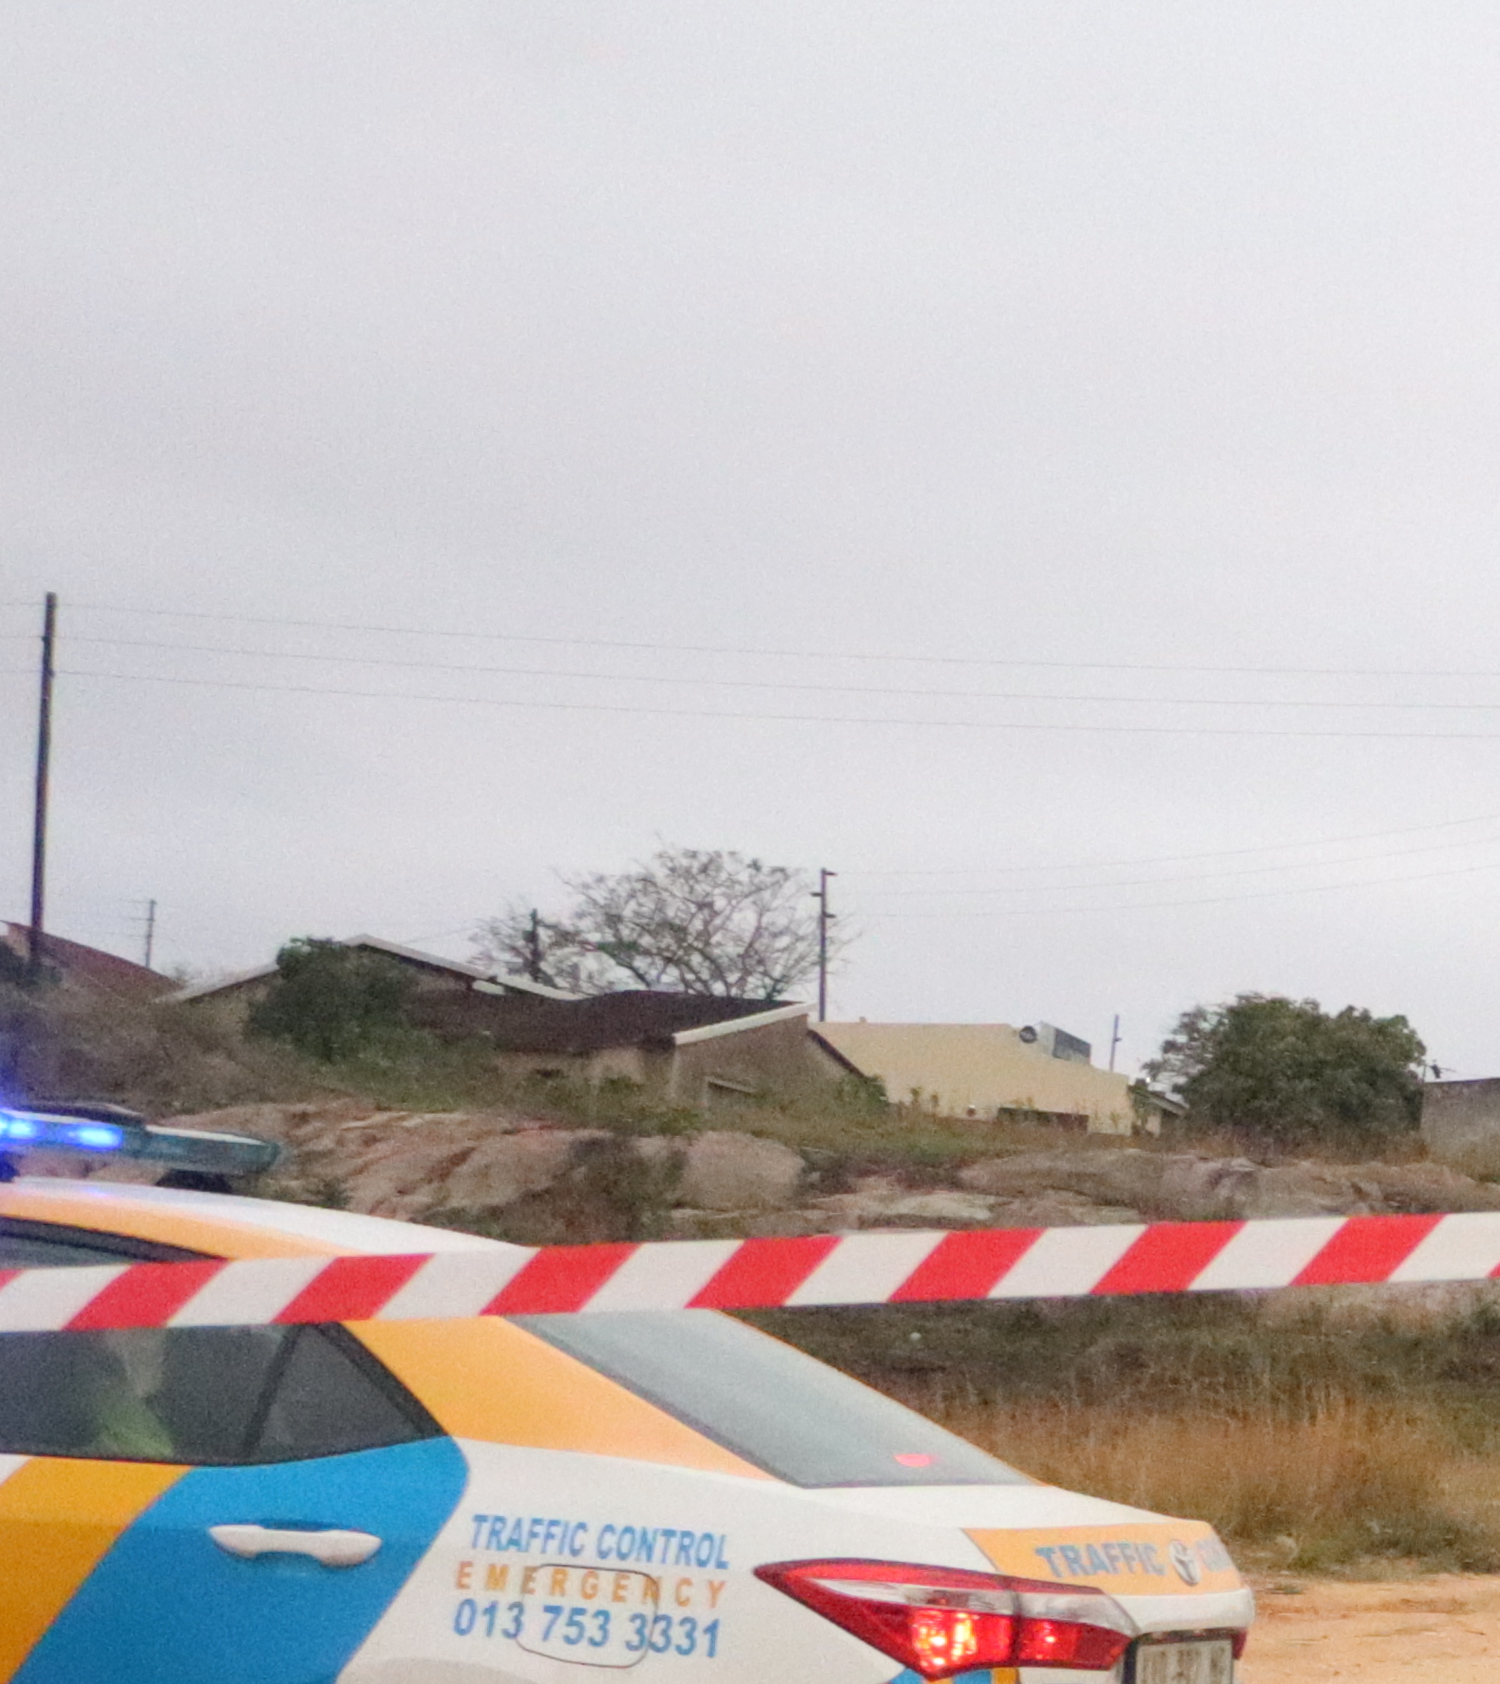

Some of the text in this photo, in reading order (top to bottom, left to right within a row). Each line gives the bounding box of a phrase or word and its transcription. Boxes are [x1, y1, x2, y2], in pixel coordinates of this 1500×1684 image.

[470, 1513, 730, 1570] TRAFFIC CONTROL
[1035, 1541, 1166, 1579] TRAFFIC
[454, 1560, 727, 1609] EMERGENCY
[453, 1597, 721, 1659] 013 753 3331
